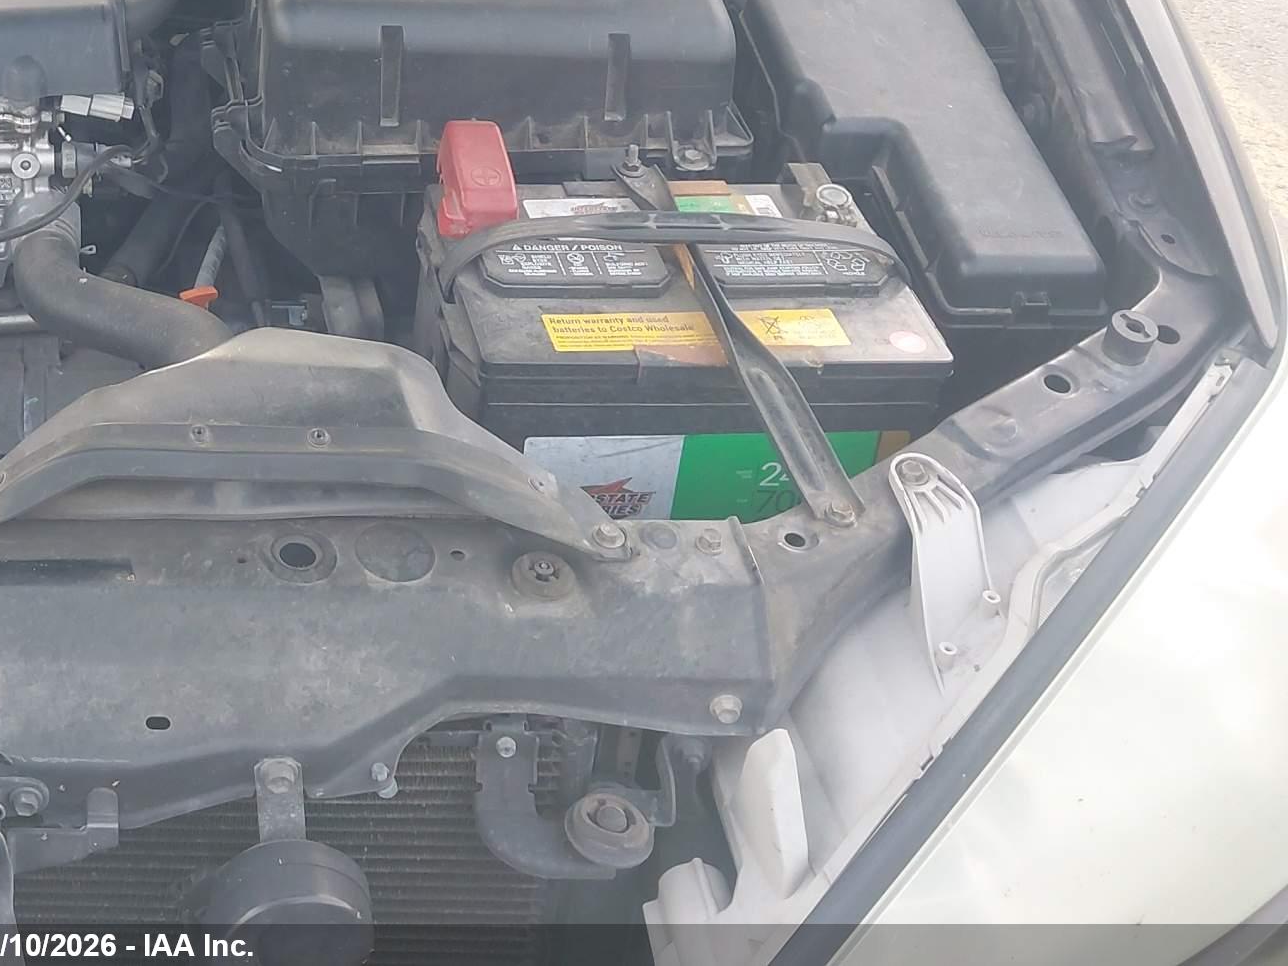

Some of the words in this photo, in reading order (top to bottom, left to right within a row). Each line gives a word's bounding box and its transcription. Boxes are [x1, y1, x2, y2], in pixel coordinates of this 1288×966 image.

[523, 243, 570, 252] DANGER
[571, 243, 579, 252] /
[580, 243, 623, 252] POISON
[549, 317, 581, 325] Return
[583, 317, 624, 326] warranty
[645, 315, 669, 323] used
[552, 325, 596, 333] batteries
[609, 325, 644, 333] Costco
[645, 323, 695, 332] Wholesale
